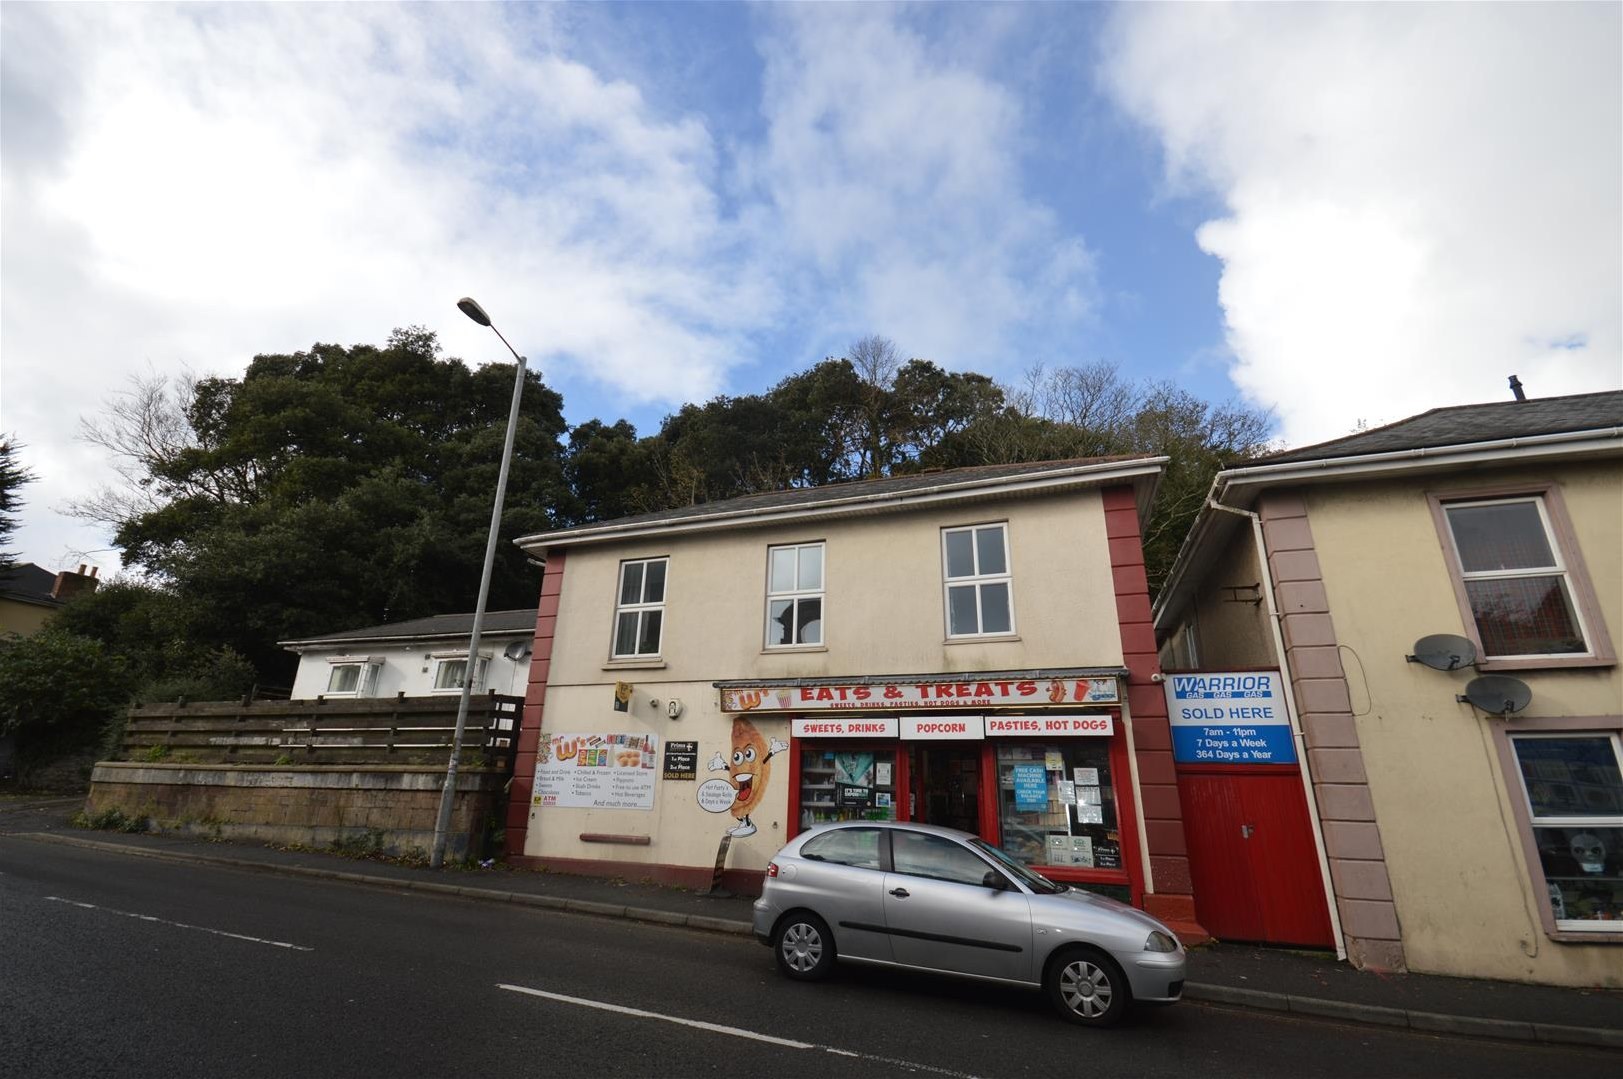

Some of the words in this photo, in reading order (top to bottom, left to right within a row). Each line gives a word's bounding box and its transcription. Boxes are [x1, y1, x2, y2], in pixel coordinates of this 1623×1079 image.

[1173, 676, 1271, 691] WARRIOR
[800, 686, 871, 701] EATS
[883, 685, 904, 699] &
[915, 681, 1037, 699] TREATS
[1182, 708, 1224, 719] SOLD
[1229, 707, 1274, 719] HERE
[803, 724, 844, 734] SWEETS,
[848, 723, 886, 733] DRINKS
[917, 723, 965, 733] POPCORN
[990, 721, 1041, 731] PASTIES,
[1045, 721, 1069, 730] HOT
[1073, 720, 1108, 730] DOGS
[1203, 728, 1223, 736] 7am
[1233, 728, 1256, 737] 11pm
[1196, 739, 1202, 747] 7
[1205, 739, 1229, 749] Days
[1240, 739, 1267, 747] Week
[1196, 750, 1214, 758] 364
[1216, 750, 1240, 760] Days
[1250, 750, 1272, 758] Year
